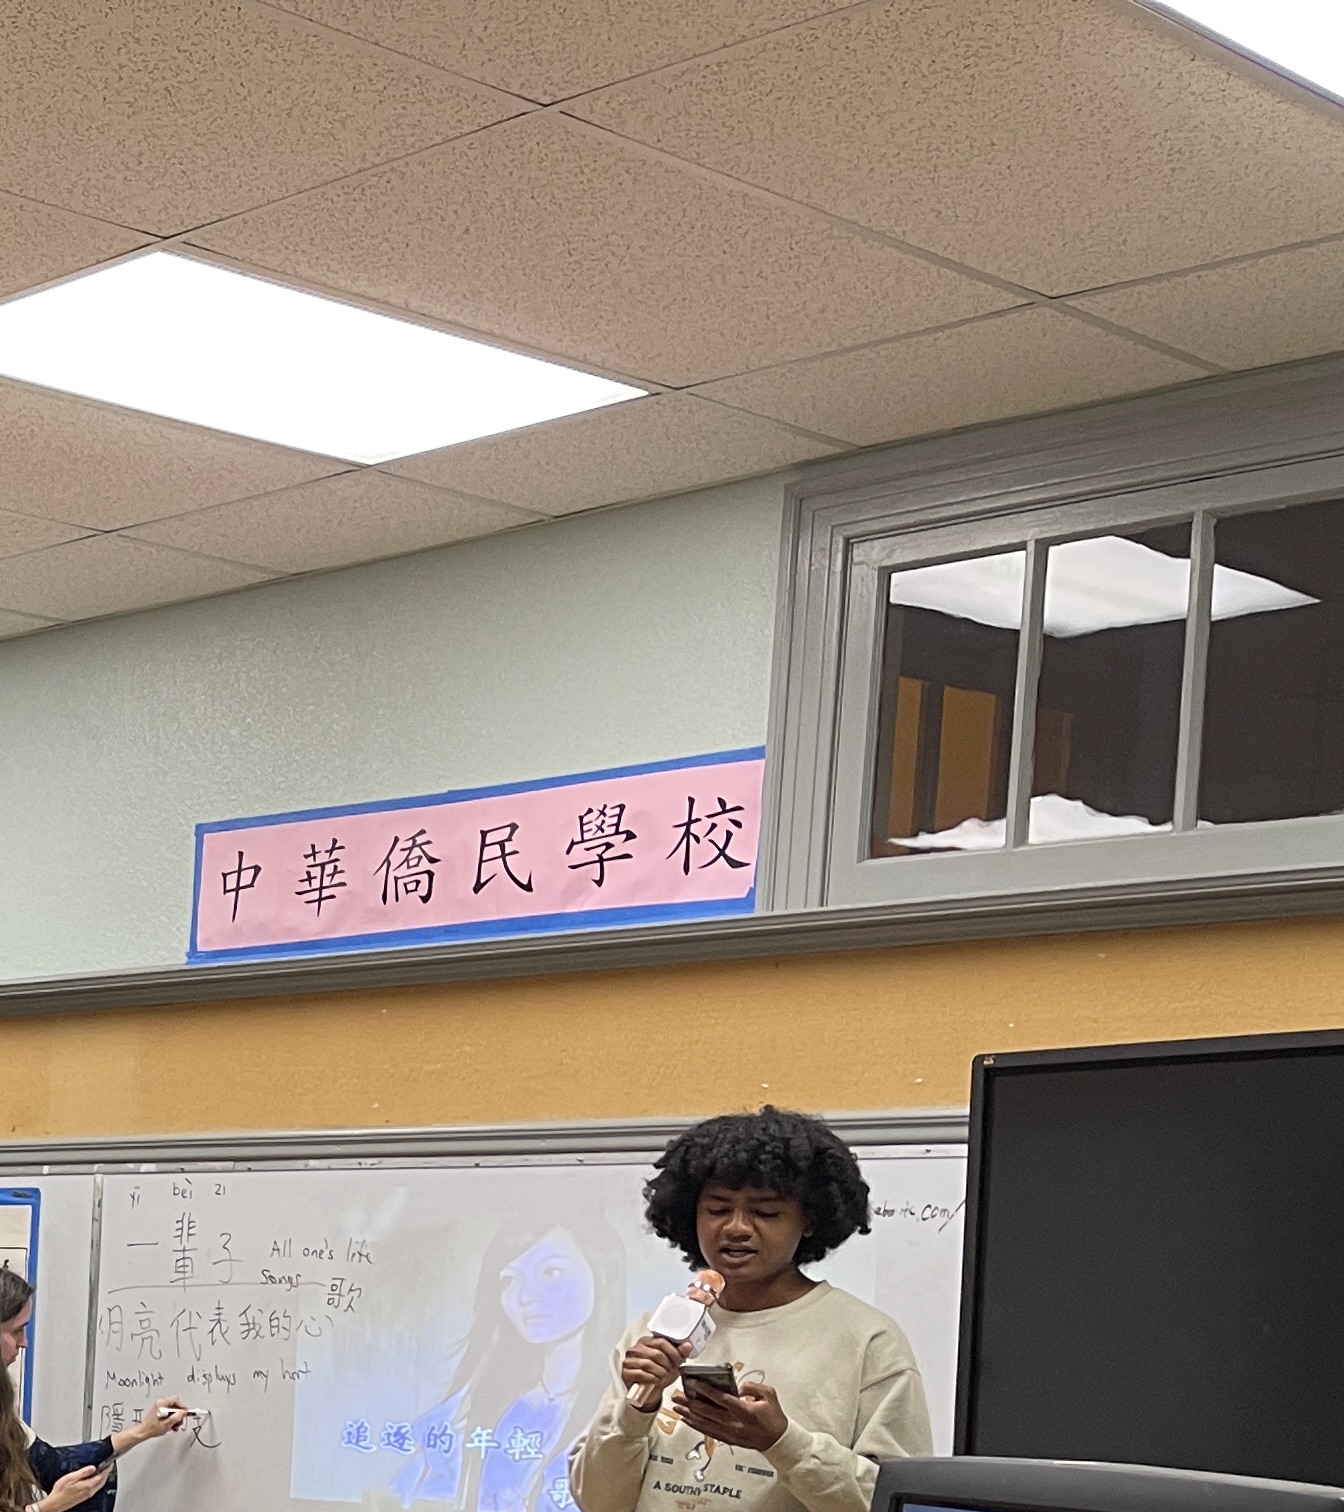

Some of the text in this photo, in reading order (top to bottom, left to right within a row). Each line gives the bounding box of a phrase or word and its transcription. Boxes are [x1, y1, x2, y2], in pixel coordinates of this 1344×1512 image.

[221, 796, 752, 923] 中華僑民學校
[126, 1211, 244, 1292] 一輩子
[270, 1237, 292, 1258] All
[302, 1237, 334, 1261] one's
[260, 1268, 302, 1288] Songs
[99, 1299, 334, 1361] 月亮代表我的心
[104, 1368, 165, 1398] Moonlight
[252, 1367, 269, 1394] my
[339, 1417, 546, 1462] 追逐的年輕
[652, 1480, 662, 1490] A
[703, 1483, 743, 1500] STAPLE
